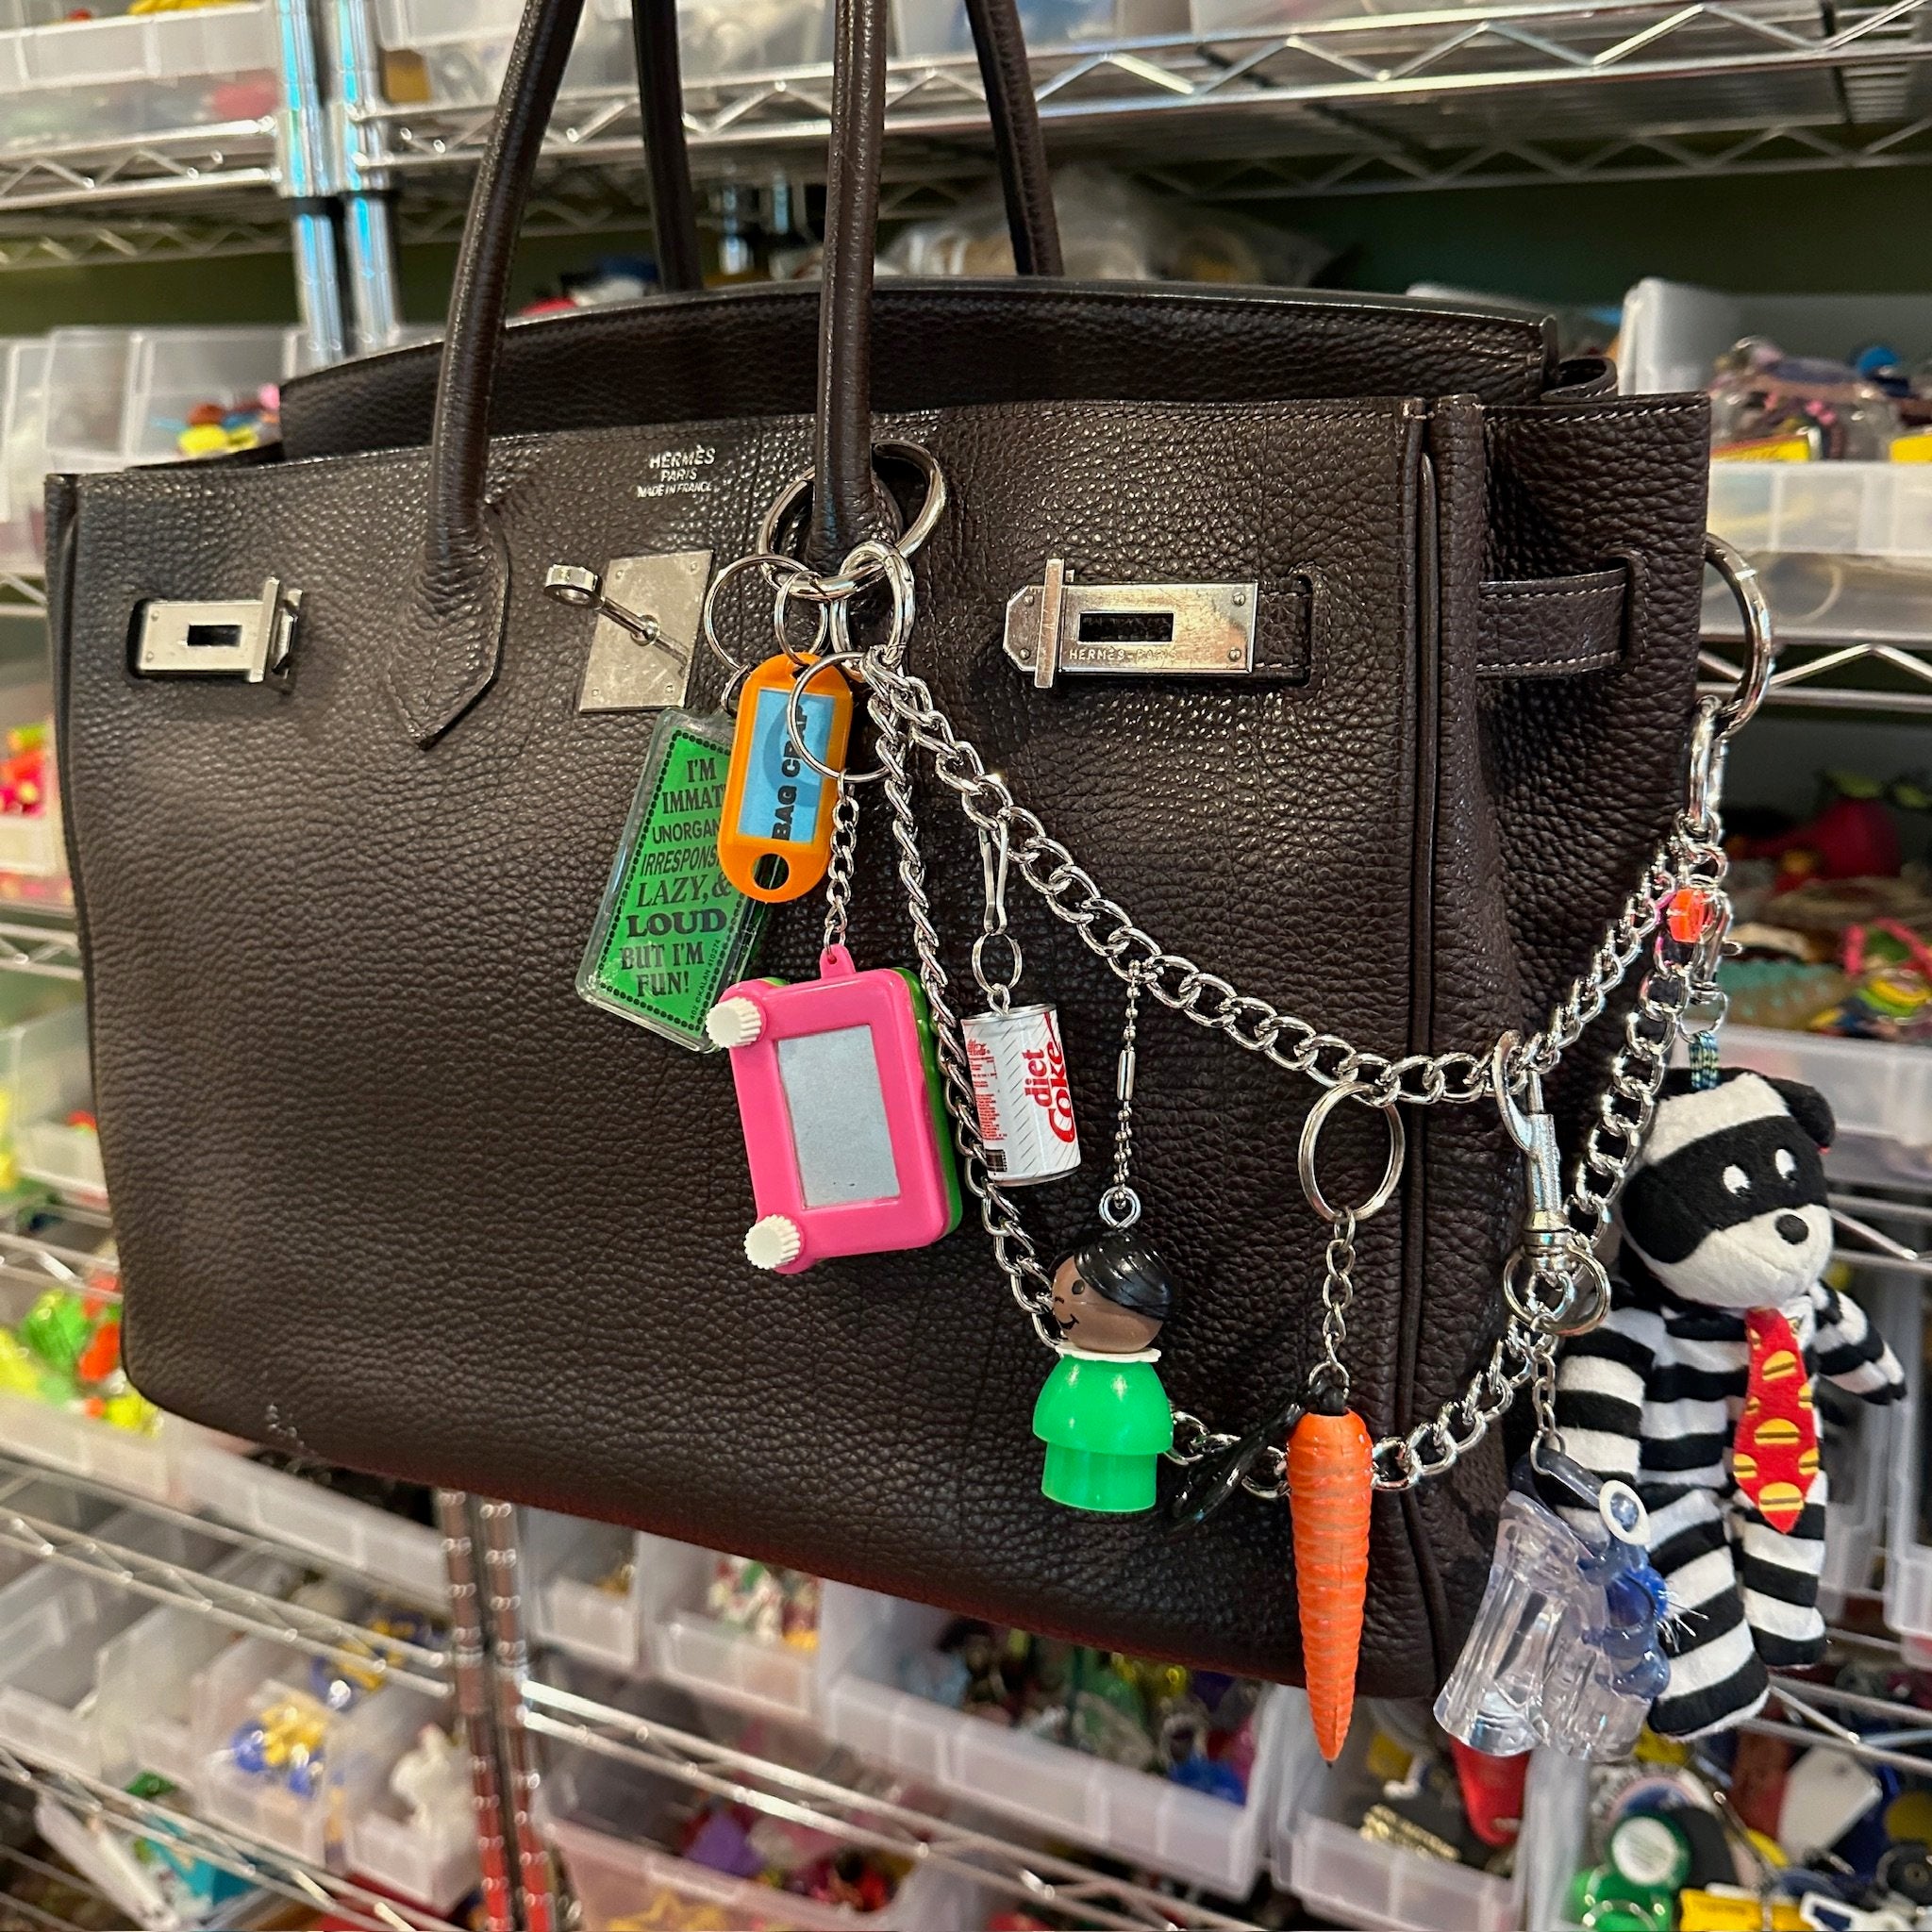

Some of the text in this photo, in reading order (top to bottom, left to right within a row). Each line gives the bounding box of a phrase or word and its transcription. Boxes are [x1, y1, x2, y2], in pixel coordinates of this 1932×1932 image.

[637, 480, 712, 498] MADE IN FRANCE
[660, 467, 697, 482] PARIS
[687, 758, 717, 783] I'M
[662, 784, 726, 814] IMMAT
[772, 785, 797, 841] BAG
[640, 845, 721, 877] IRRESPONS
[637, 872, 732, 908] LAZY, &
[626, 908, 727, 938] LOUD
[620, 941, 705, 970] BUT I'M
[637, 971, 690, 997] FUN!
[1046, 1041, 1076, 1143] Coke
